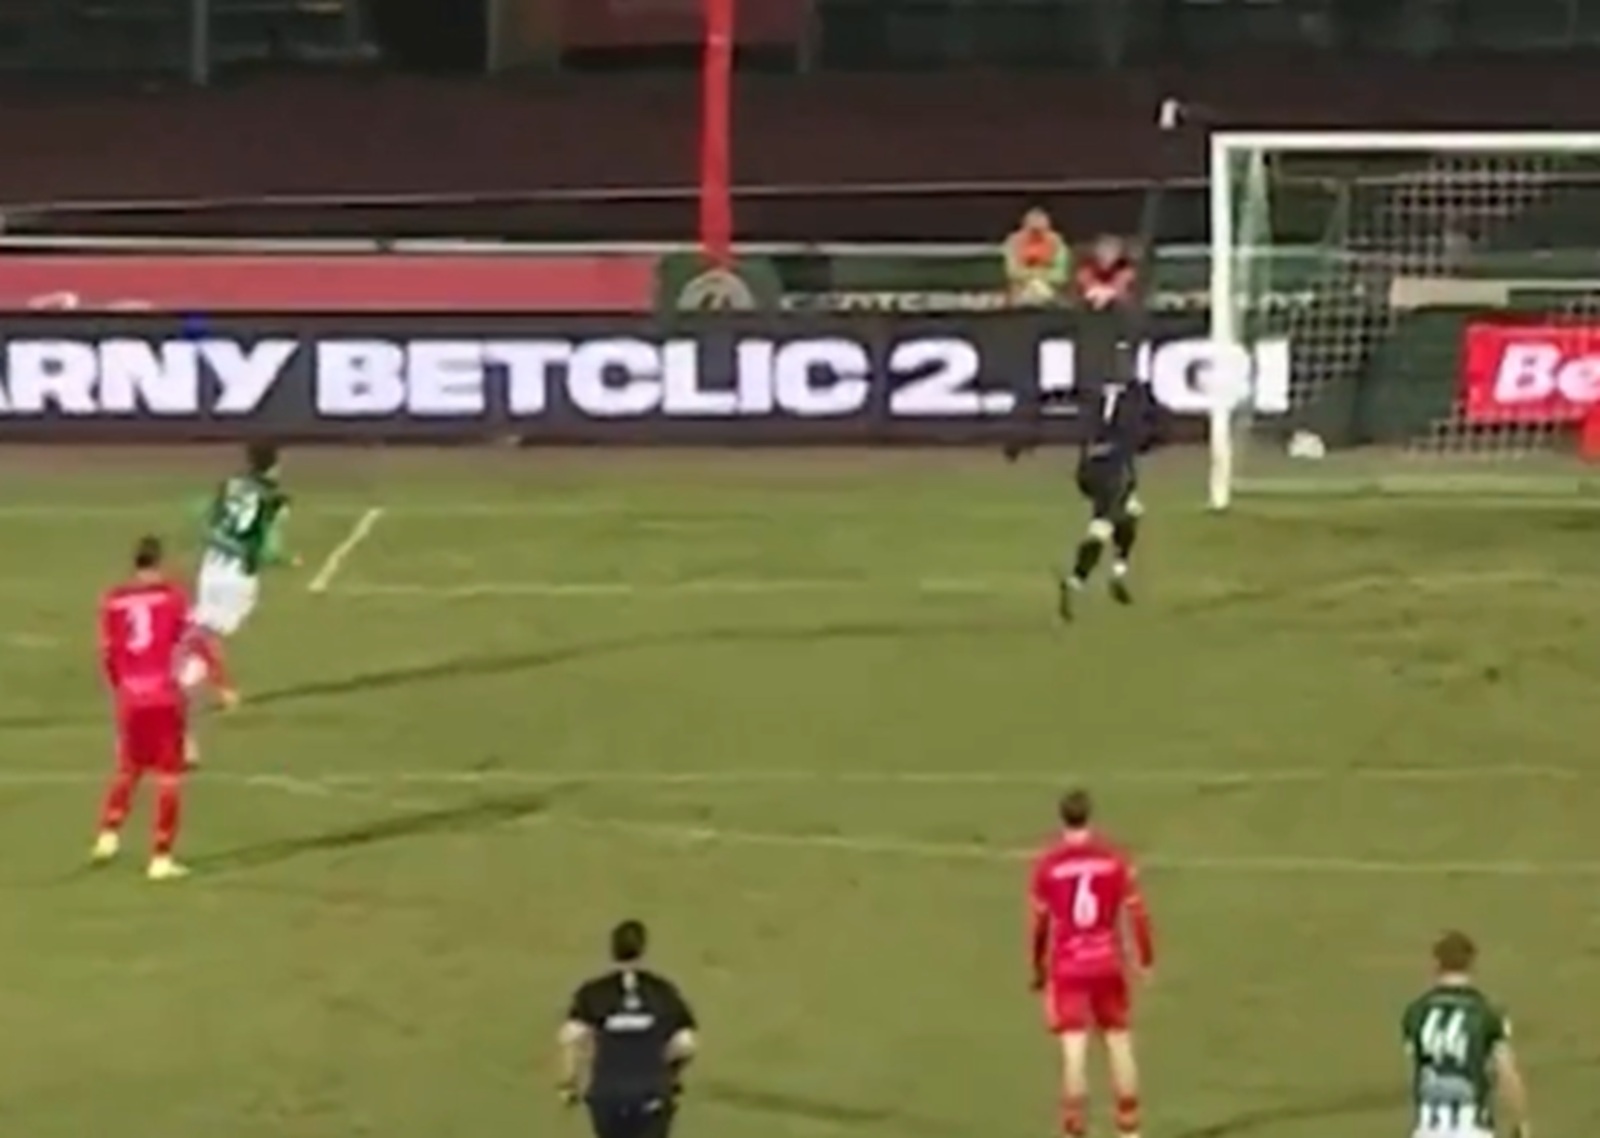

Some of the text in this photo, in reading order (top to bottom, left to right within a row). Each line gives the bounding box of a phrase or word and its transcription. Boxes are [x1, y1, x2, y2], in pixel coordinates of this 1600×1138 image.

[0, 339, 298, 413] RNY
[316, 339, 868, 415] BETCLIC
[889, 339, 1016, 414] 2.
[1073, 872, 1097, 928] 6
[1421, 1007, 1470, 1066] 44
